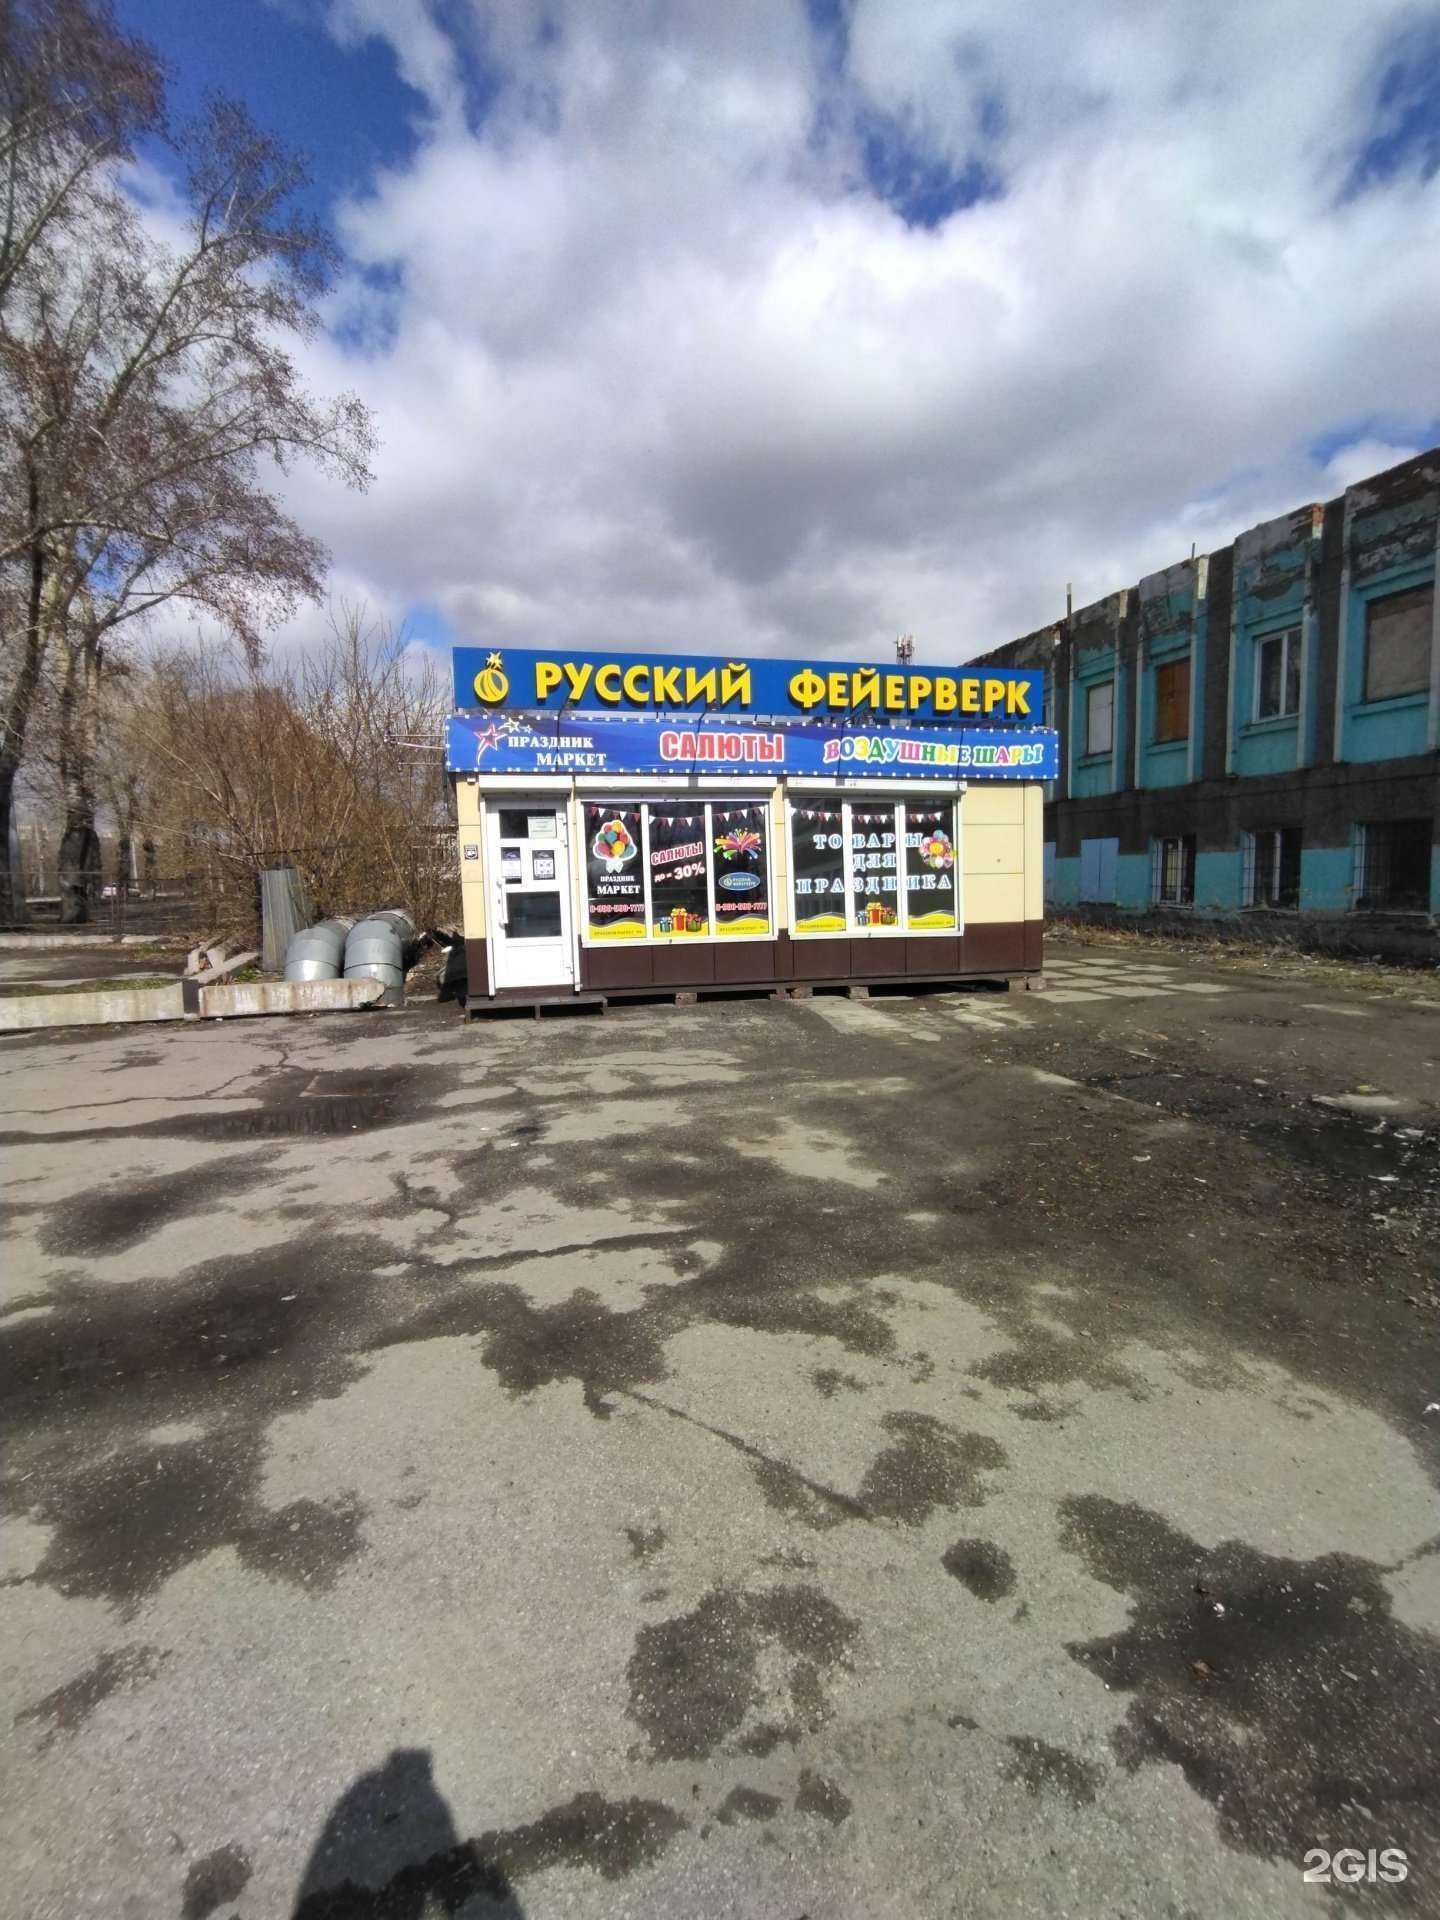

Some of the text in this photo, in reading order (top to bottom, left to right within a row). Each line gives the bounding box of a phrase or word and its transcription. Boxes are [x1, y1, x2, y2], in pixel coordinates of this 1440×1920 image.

[535, 662, 1032, 714] РУССКИЙ ФЕЙЕРВЕРК
[507, 735, 594, 751] ПРАЗДНИК
[660, 730, 785, 762] САЛЮТЫ
[823, 735, 1045, 767] ВОЗДУШНЫЕ ШАРЫ
[536, 752, 607, 767] МАРКЕТ
[813, 832, 923, 850] ТОВАРЫ
[650, 841, 703, 866] САЛЮТЫ
[853, 852, 897, 872] ДЛЯ
[600, 875, 635, 883] ПРАЗДНИК
[796, 874, 952, 895] ПРАЗДНИКА
[597, 885, 641, 895] МАРКЕТ
